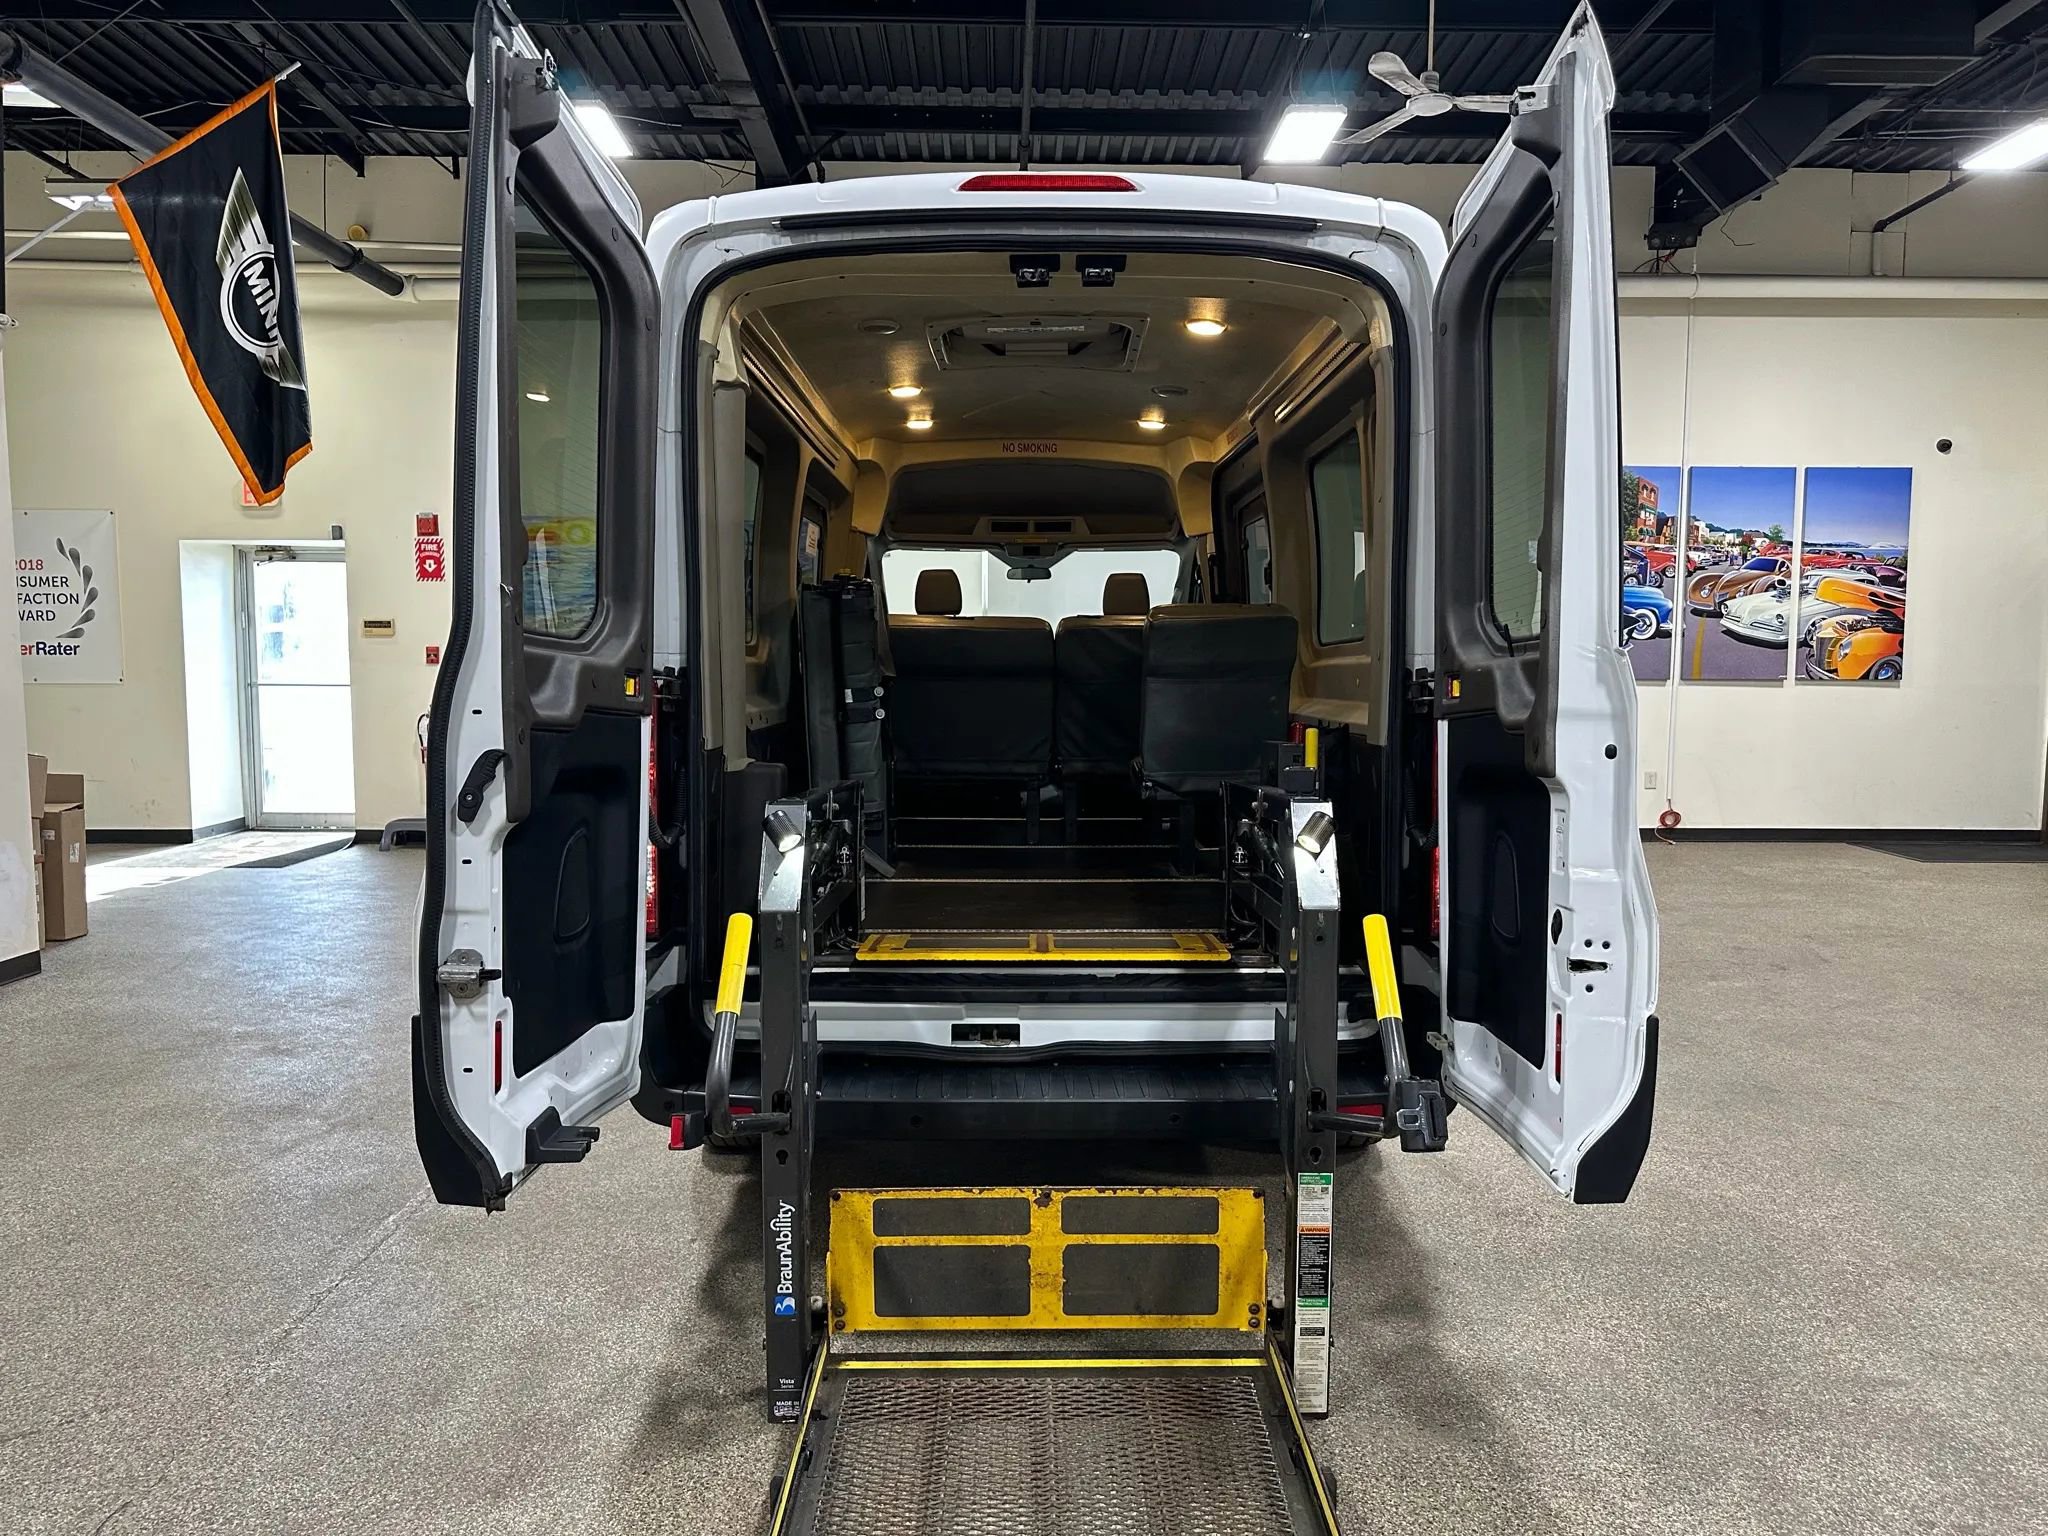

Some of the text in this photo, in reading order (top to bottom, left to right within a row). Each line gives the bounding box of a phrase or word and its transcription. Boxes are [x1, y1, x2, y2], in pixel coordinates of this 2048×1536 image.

[1002, 442, 1058, 453] NO SMOKING
[420, 543, 439, 551] FIRE
[15, 559, 44, 571] 018
[16, 575, 69, 588] SUMER
[17, 592, 80, 605] FACTION
[771, 1200, 796, 1294] BraunAbility
